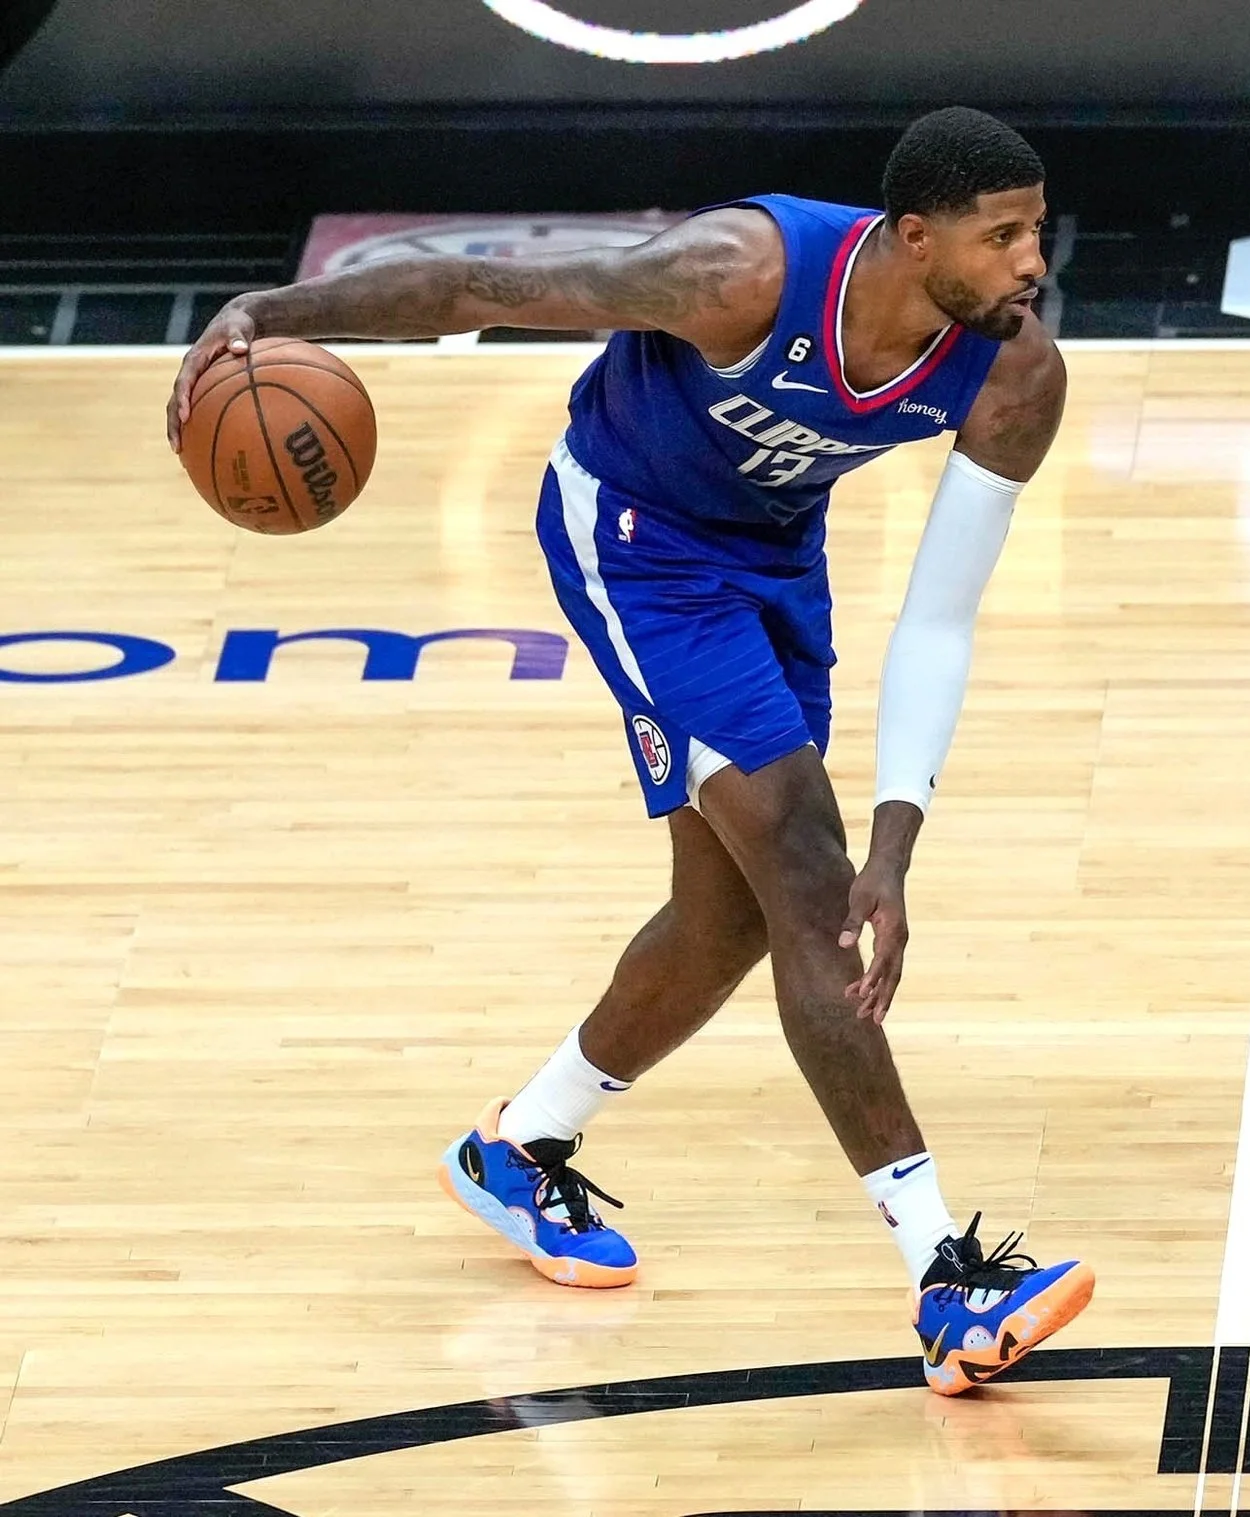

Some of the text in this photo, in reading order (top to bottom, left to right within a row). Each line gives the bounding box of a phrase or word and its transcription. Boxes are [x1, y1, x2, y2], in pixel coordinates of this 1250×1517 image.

[788, 337, 811, 362] 6
[898, 398, 948, 424] honey
[738, 449, 816, 487] 13
